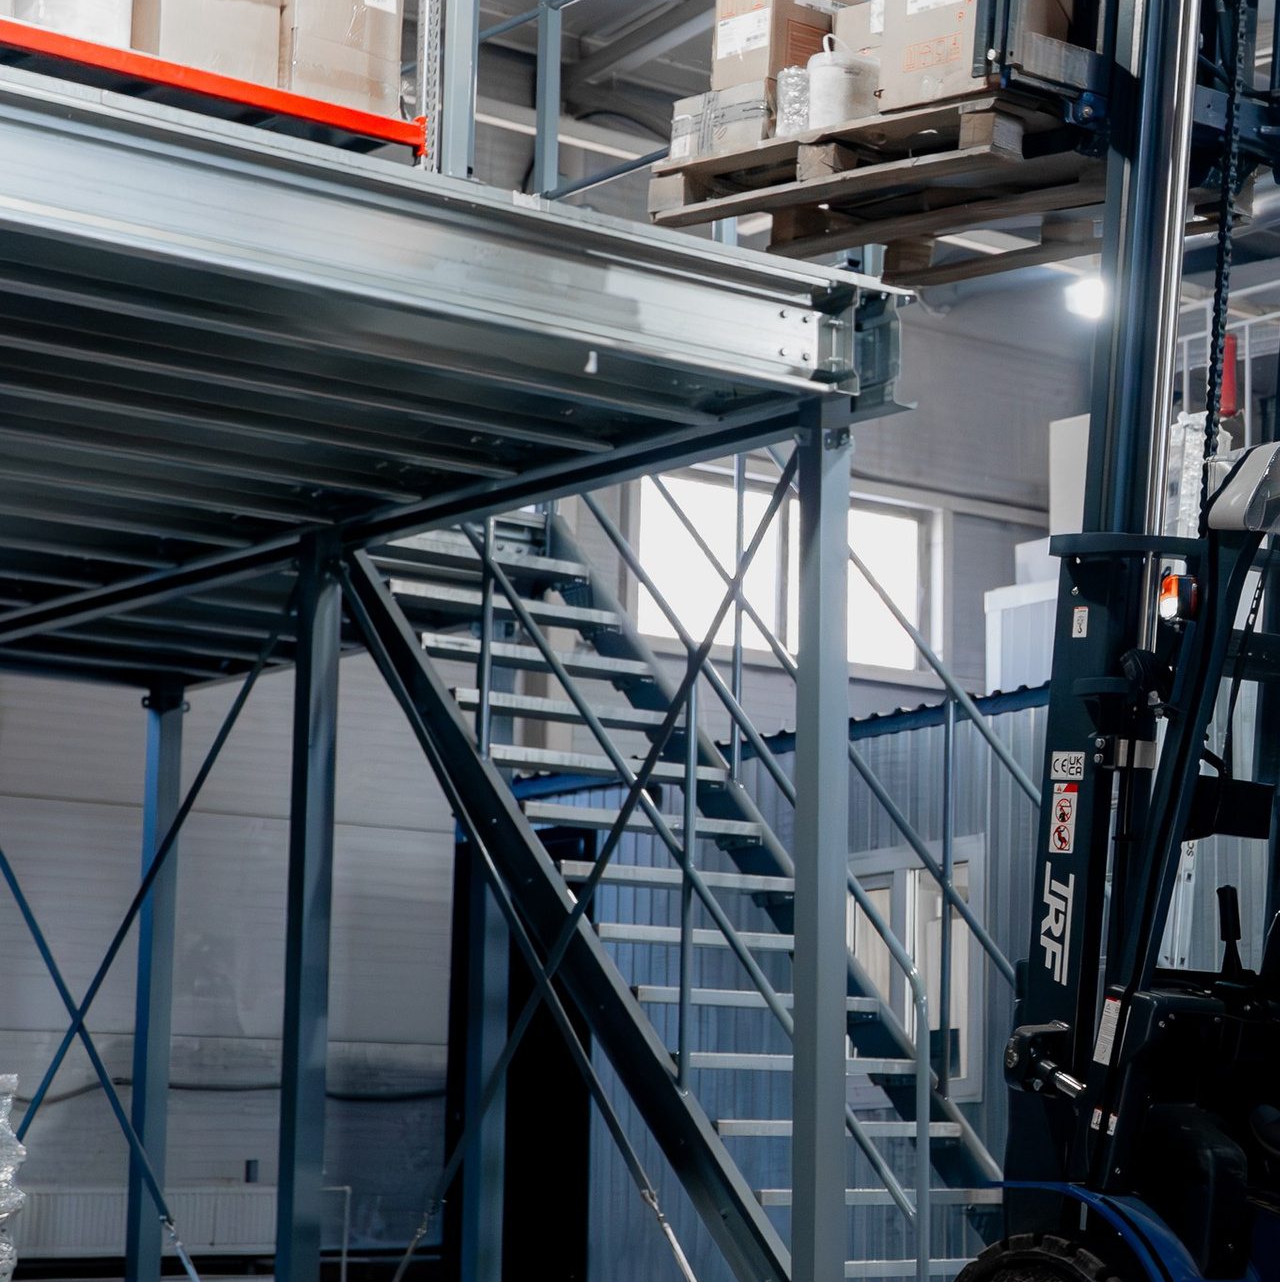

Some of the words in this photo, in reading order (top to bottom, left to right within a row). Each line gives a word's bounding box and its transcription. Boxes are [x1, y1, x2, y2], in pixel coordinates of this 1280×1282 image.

[1052, 758, 1068, 774] CE
[1069, 755, 1083, 766] UK
[1068, 766, 1083, 776] CA
[1040, 860, 1076, 987] TRF
